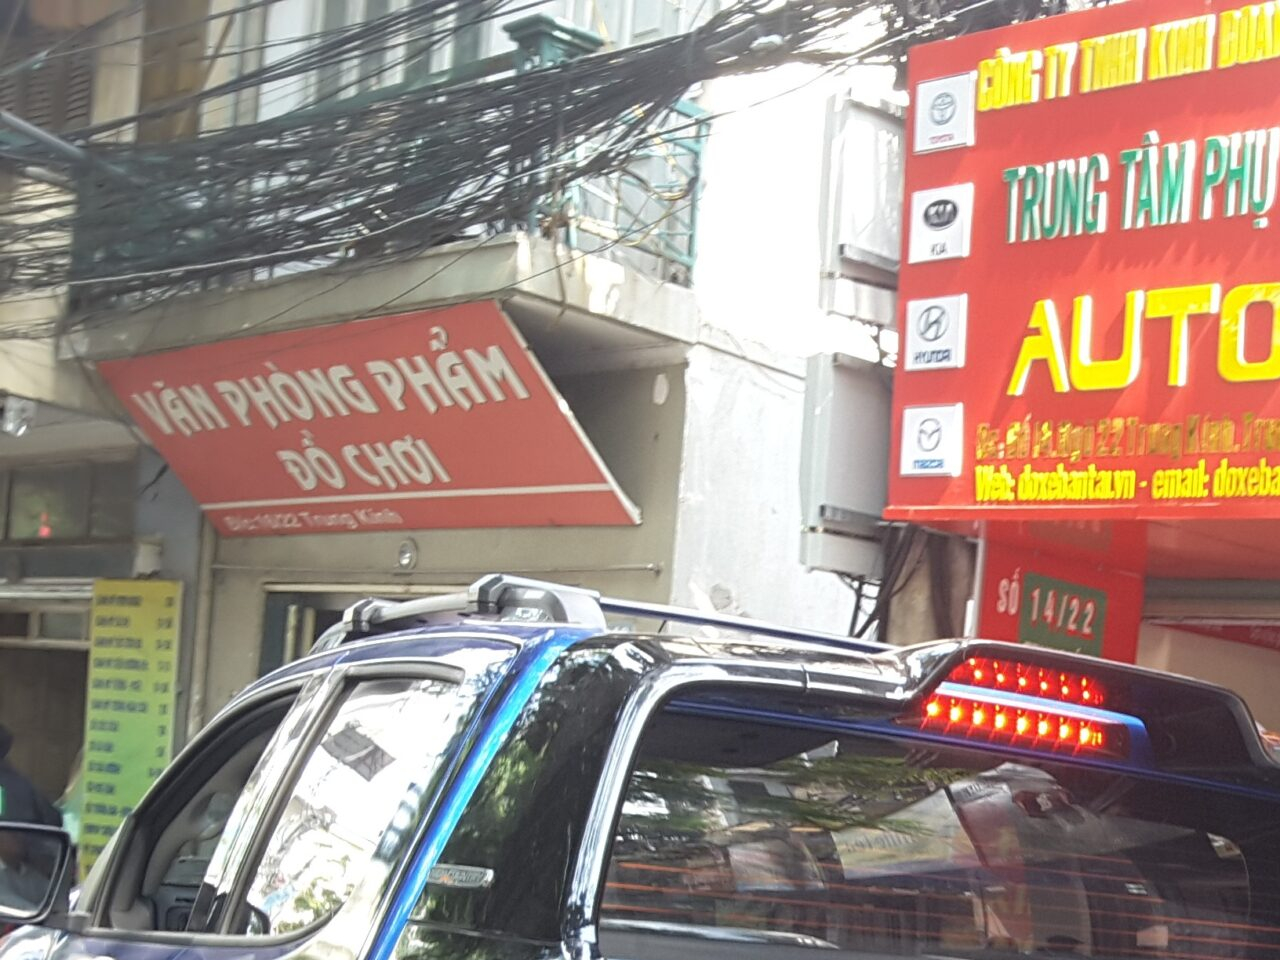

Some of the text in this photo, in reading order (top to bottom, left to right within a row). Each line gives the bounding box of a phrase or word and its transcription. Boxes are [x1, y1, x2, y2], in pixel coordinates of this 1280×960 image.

[1044, 42, 1078, 99] TY
[1003, 154, 1108, 243] TRUNG
[1120, 131, 1196, 229] TÂM
[1200, 127, 1280, 229] PHỤ
[129, 326, 530, 438] VĂN PHÒNG PHẨM
[277, 428, 451, 491] ĐỒ CHƠI
[1152, 458, 1209, 499] email:
[996, 567, 1096, 640] SỐ 14/22
